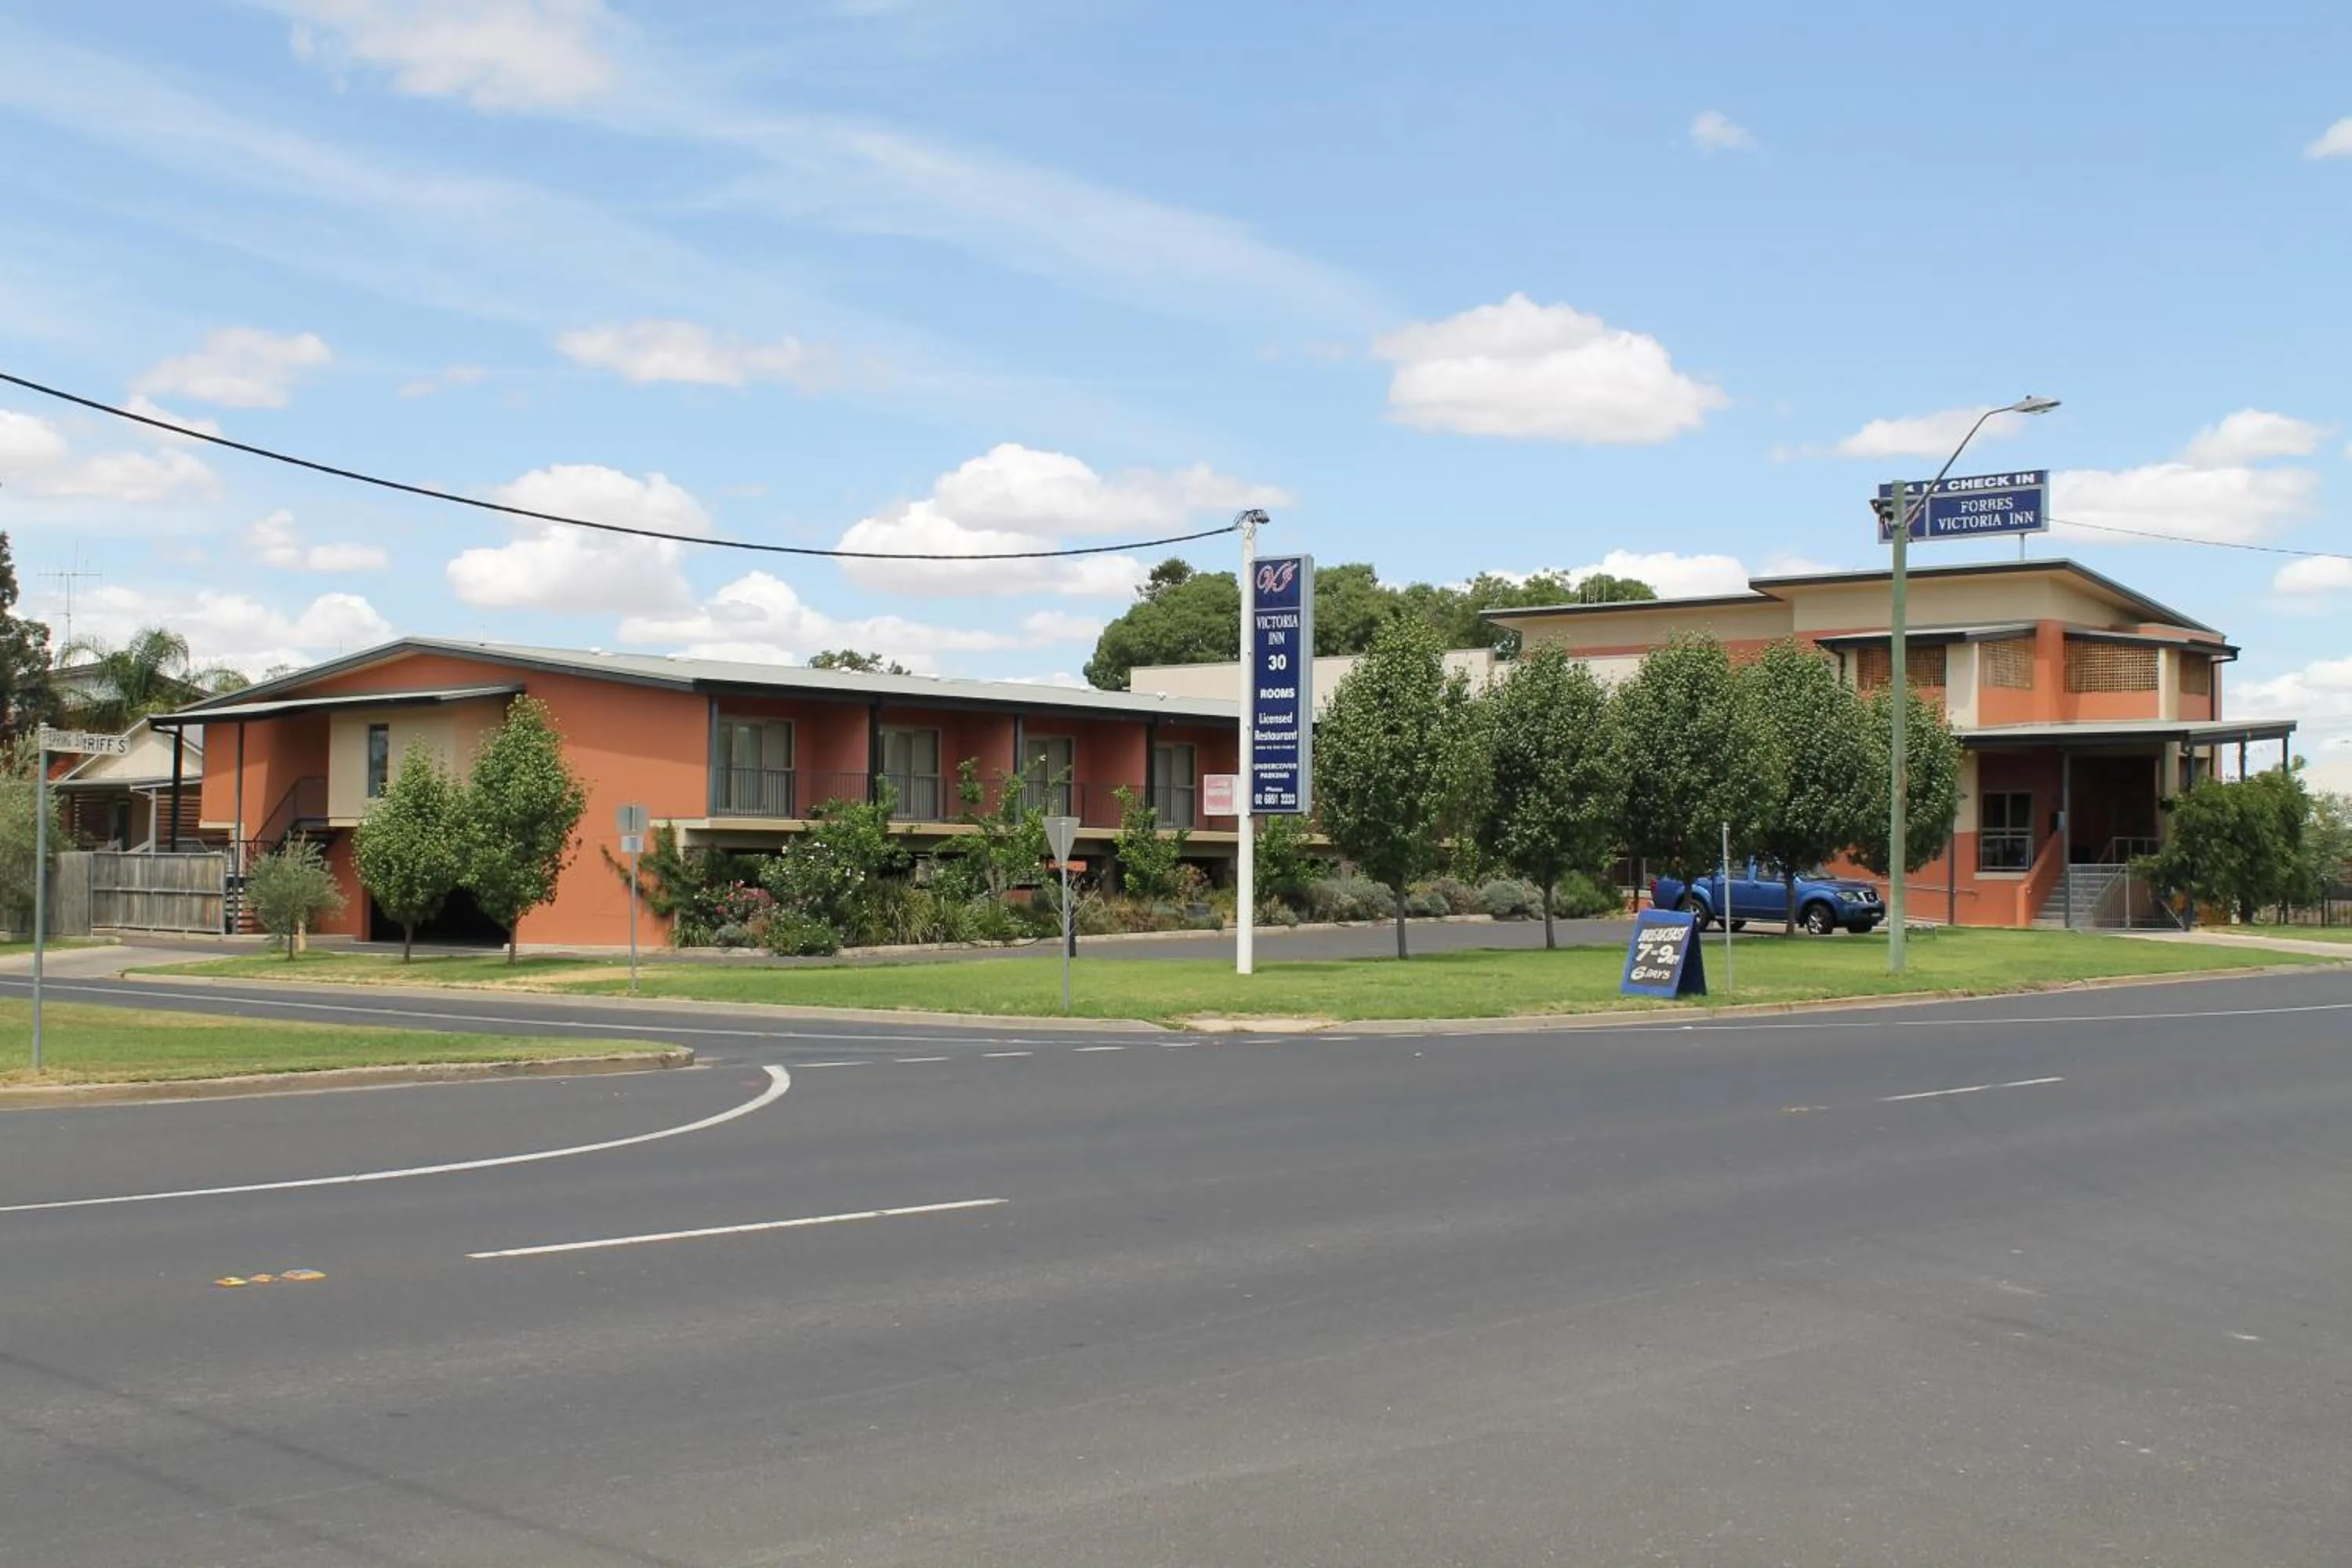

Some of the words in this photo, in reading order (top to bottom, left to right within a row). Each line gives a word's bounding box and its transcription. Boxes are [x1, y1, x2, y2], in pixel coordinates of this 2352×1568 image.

[1947, 475, 2010, 491] CHECK
[2015, 473, 2035, 485] IN
[1961, 496, 2013, 514] FORBES
[1938, 514, 2002, 530] VICTORIA
[2009, 510, 2034, 524] INN
[1256, 615, 1298, 630] VICTORIA
[1268, 631, 1285, 645] INN
[1268, 654, 1287, 670] 30
[1260, 688, 1295, 699] ROOMS
[1258, 712, 1293, 724] Licensed
[1254, 730, 1298, 741] Restaurant
